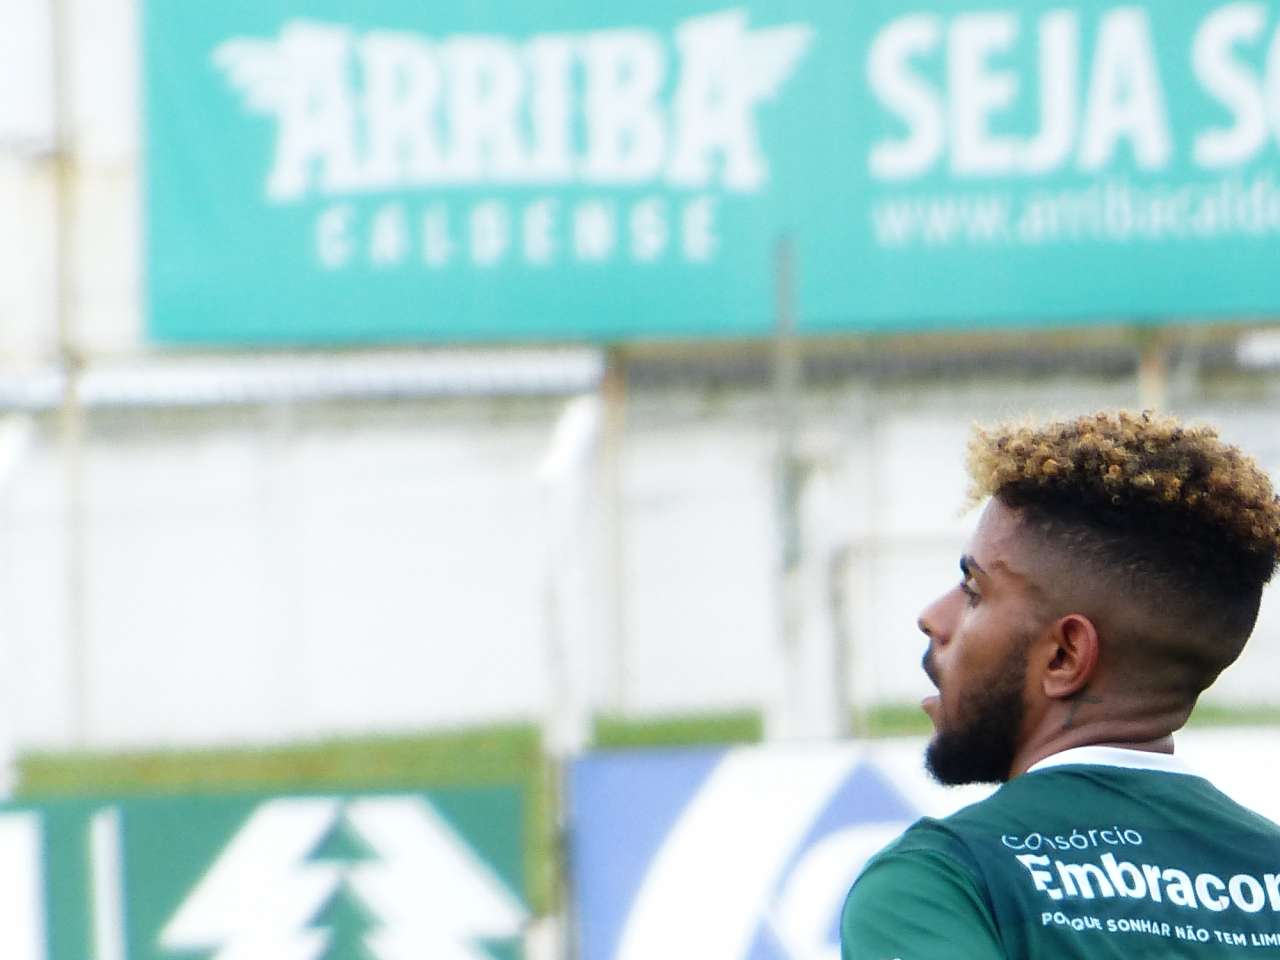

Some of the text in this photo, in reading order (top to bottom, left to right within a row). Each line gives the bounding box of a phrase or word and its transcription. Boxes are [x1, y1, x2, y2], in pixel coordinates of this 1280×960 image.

[262, 10, 772, 202] ARRIBA
[866, 8, 1172, 180] SEJA
[314, 199, 718, 268] CALDENSE
[1106, 917, 1171, 938] SONHAR
[1174, 924, 1210, 943] NÃO
[1213, 929, 1247, 947] TEM
